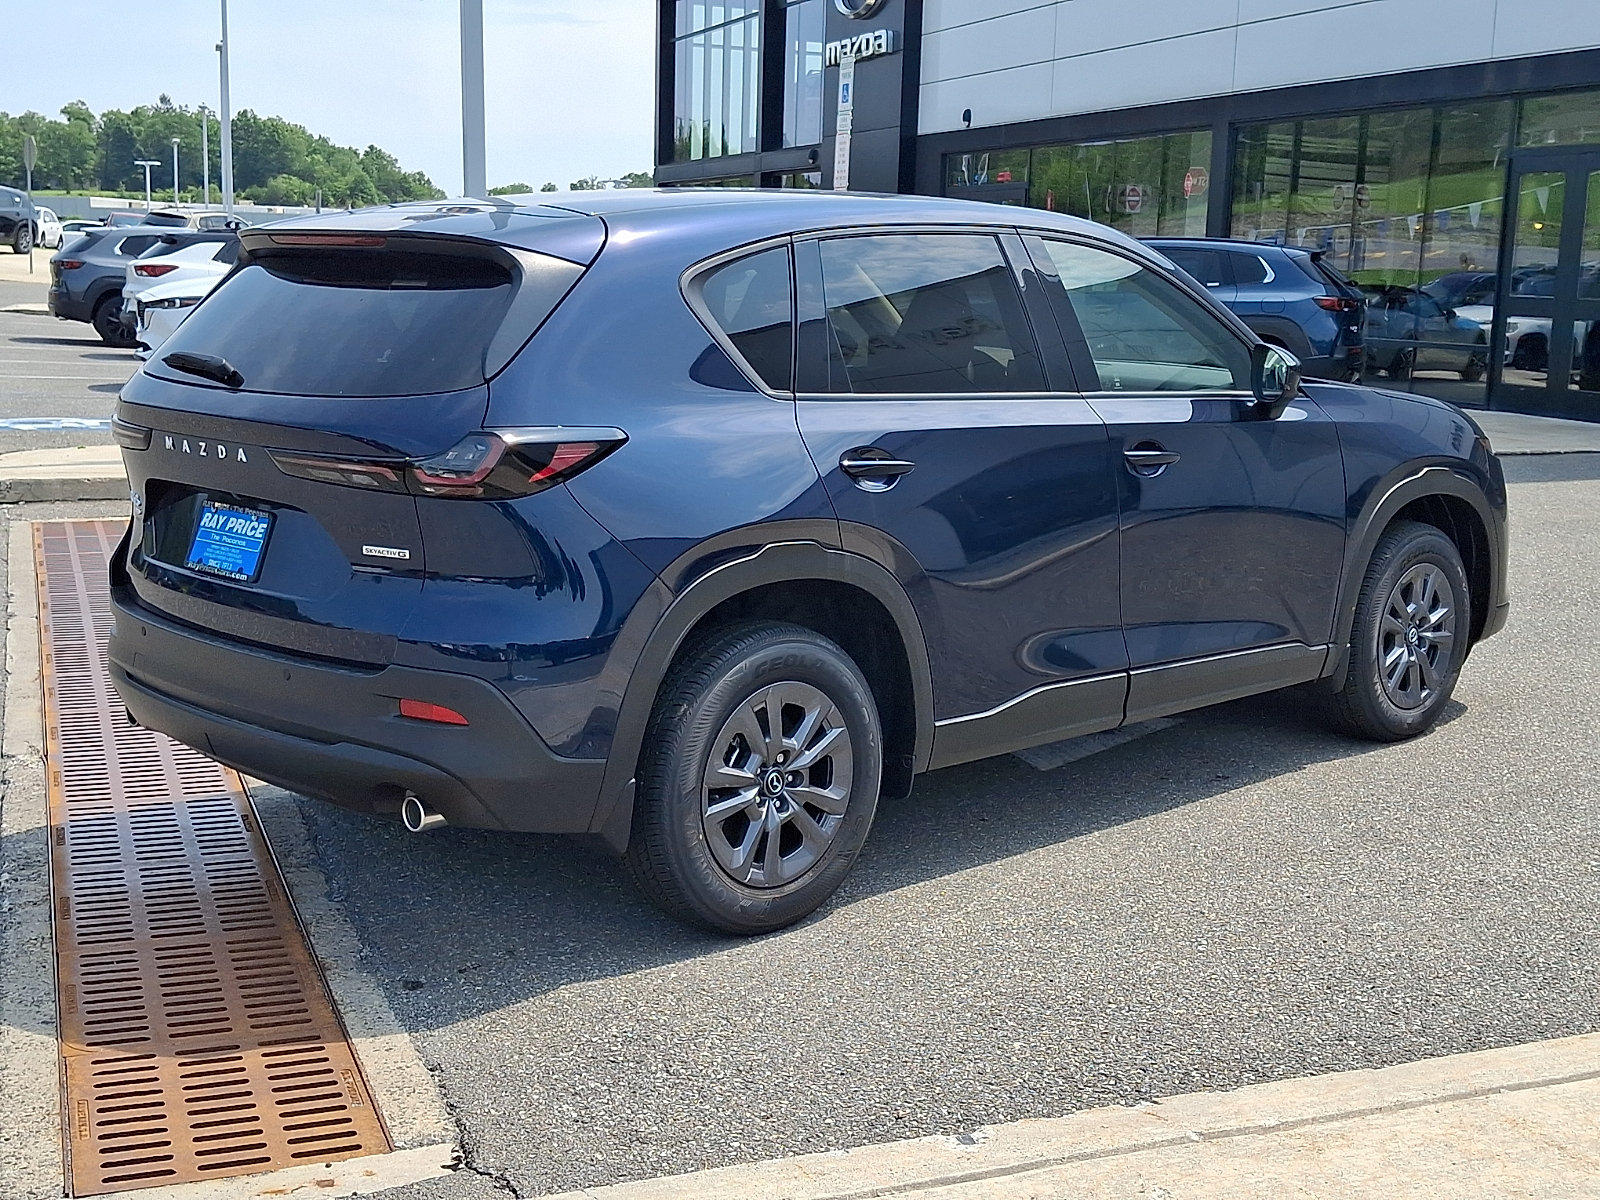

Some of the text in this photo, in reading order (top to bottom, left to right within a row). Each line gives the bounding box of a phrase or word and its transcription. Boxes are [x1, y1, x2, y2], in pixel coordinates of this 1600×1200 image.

[826, 29, 892, 67] mazda
[164, 434, 249, 464] MAZDA
[200, 512, 268, 538] RAY PRICE
[210, 533, 247, 547] The Poconos
